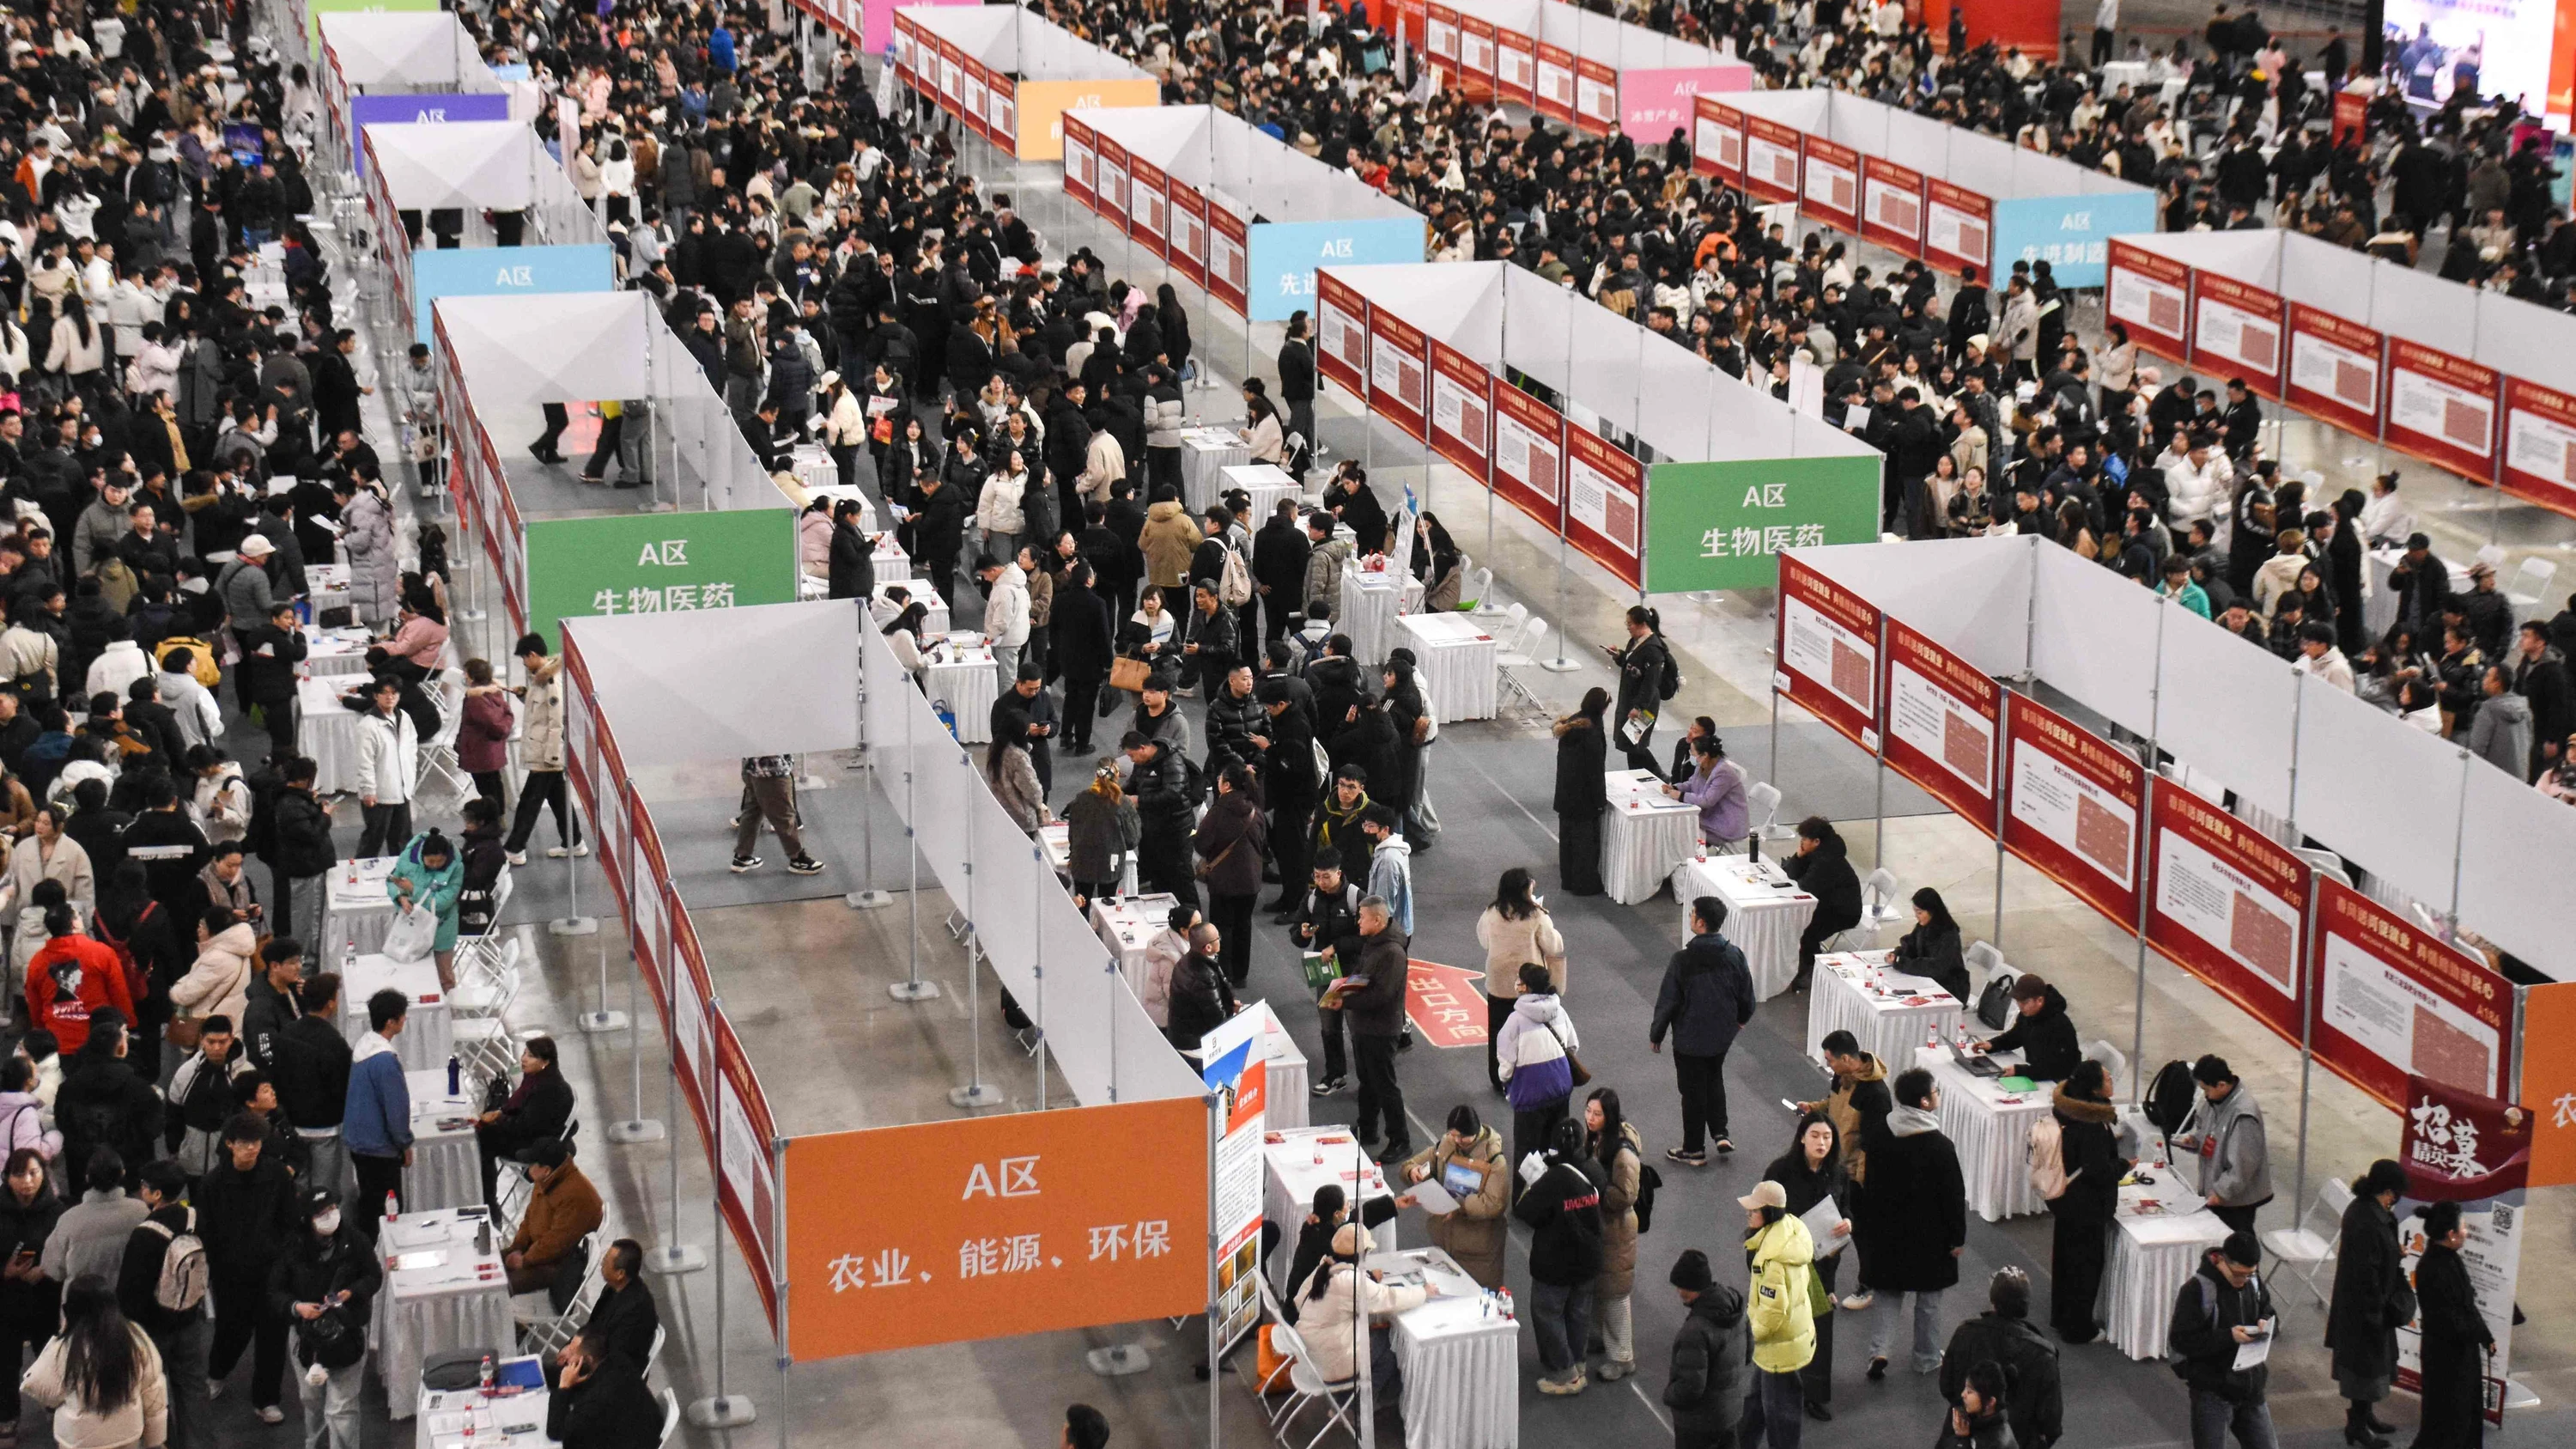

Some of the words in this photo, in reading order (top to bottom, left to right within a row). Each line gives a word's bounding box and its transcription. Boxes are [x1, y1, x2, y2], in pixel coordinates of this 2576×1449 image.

[2060, 211, 2091, 230] A区
[1321, 238, 1353, 258] A区
[495, 265, 534, 286] A区
[1742, 483, 1787, 508] A区
[638, 539, 689, 566] A区
[1699, 523, 1826, 557] 生物医药
[592, 581, 735, 615] 生物医药
[1408, 977, 1489, 1039] 出口方向
[2412, 1139, 2450, 1169] 精英
[962, 1155, 1042, 1201] A区
[827, 1220, 1171, 1294] 农业、能源、环保
